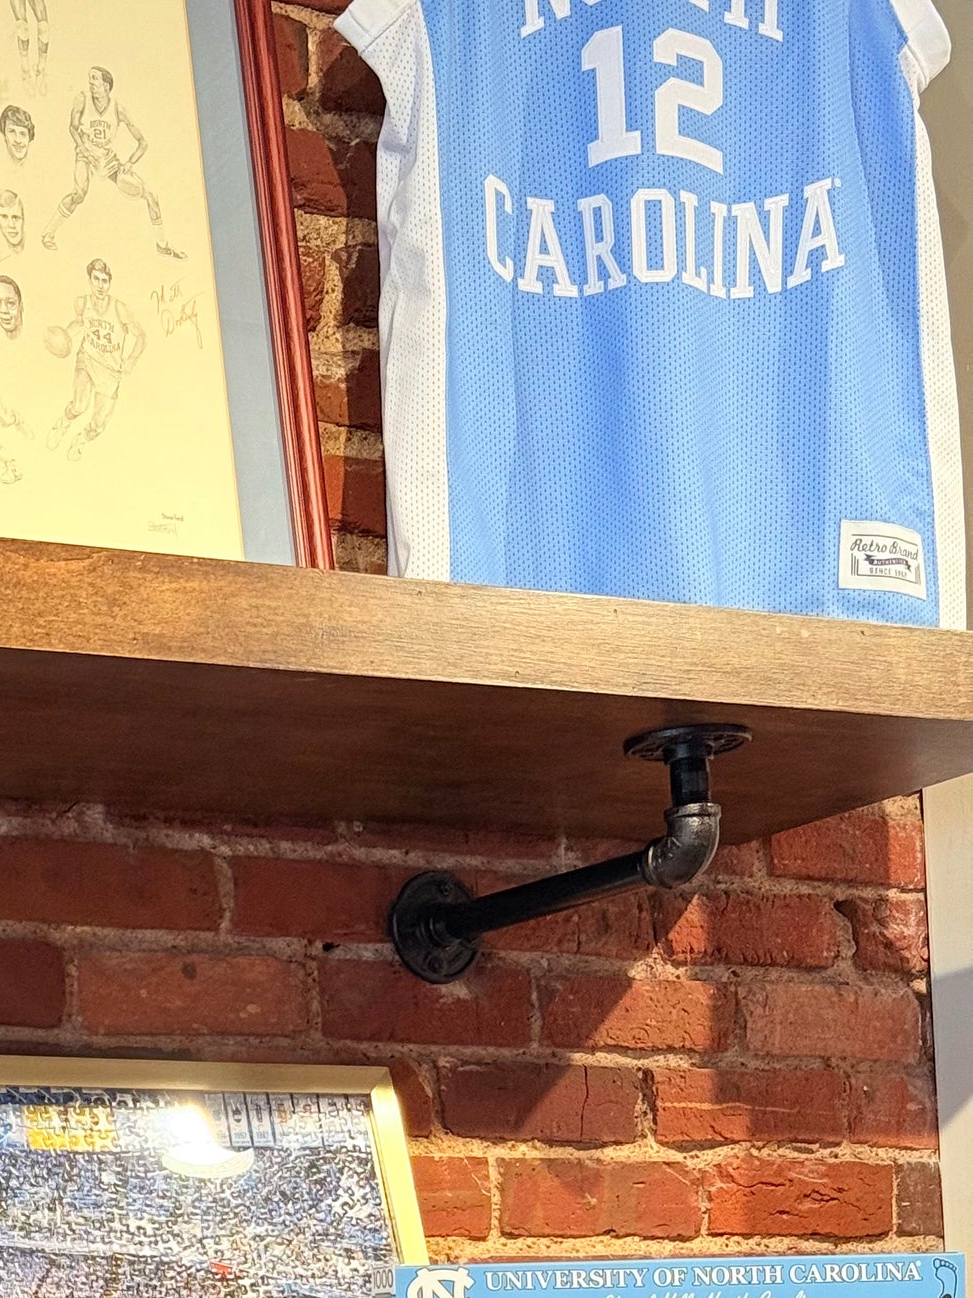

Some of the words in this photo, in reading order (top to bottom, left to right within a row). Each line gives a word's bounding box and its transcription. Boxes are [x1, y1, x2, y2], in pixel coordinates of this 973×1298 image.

[581, 25, 724, 174] 12
[93, 128, 107, 140] 21
[484, 174, 846, 299] CAROLINA
[92, 329, 113, 345] 44
[850, 538, 887, 553] Retro
[889, 541, 919, 561] Brand
[372, 1268, 394, 1289] 1000
[485, 1268, 648, 1290] UNIVERSITY
[653, 1266, 688, 1288] OF
[692, 1264, 784, 1286] NORTH
[789, 1261, 923, 1284] CAROLINA
